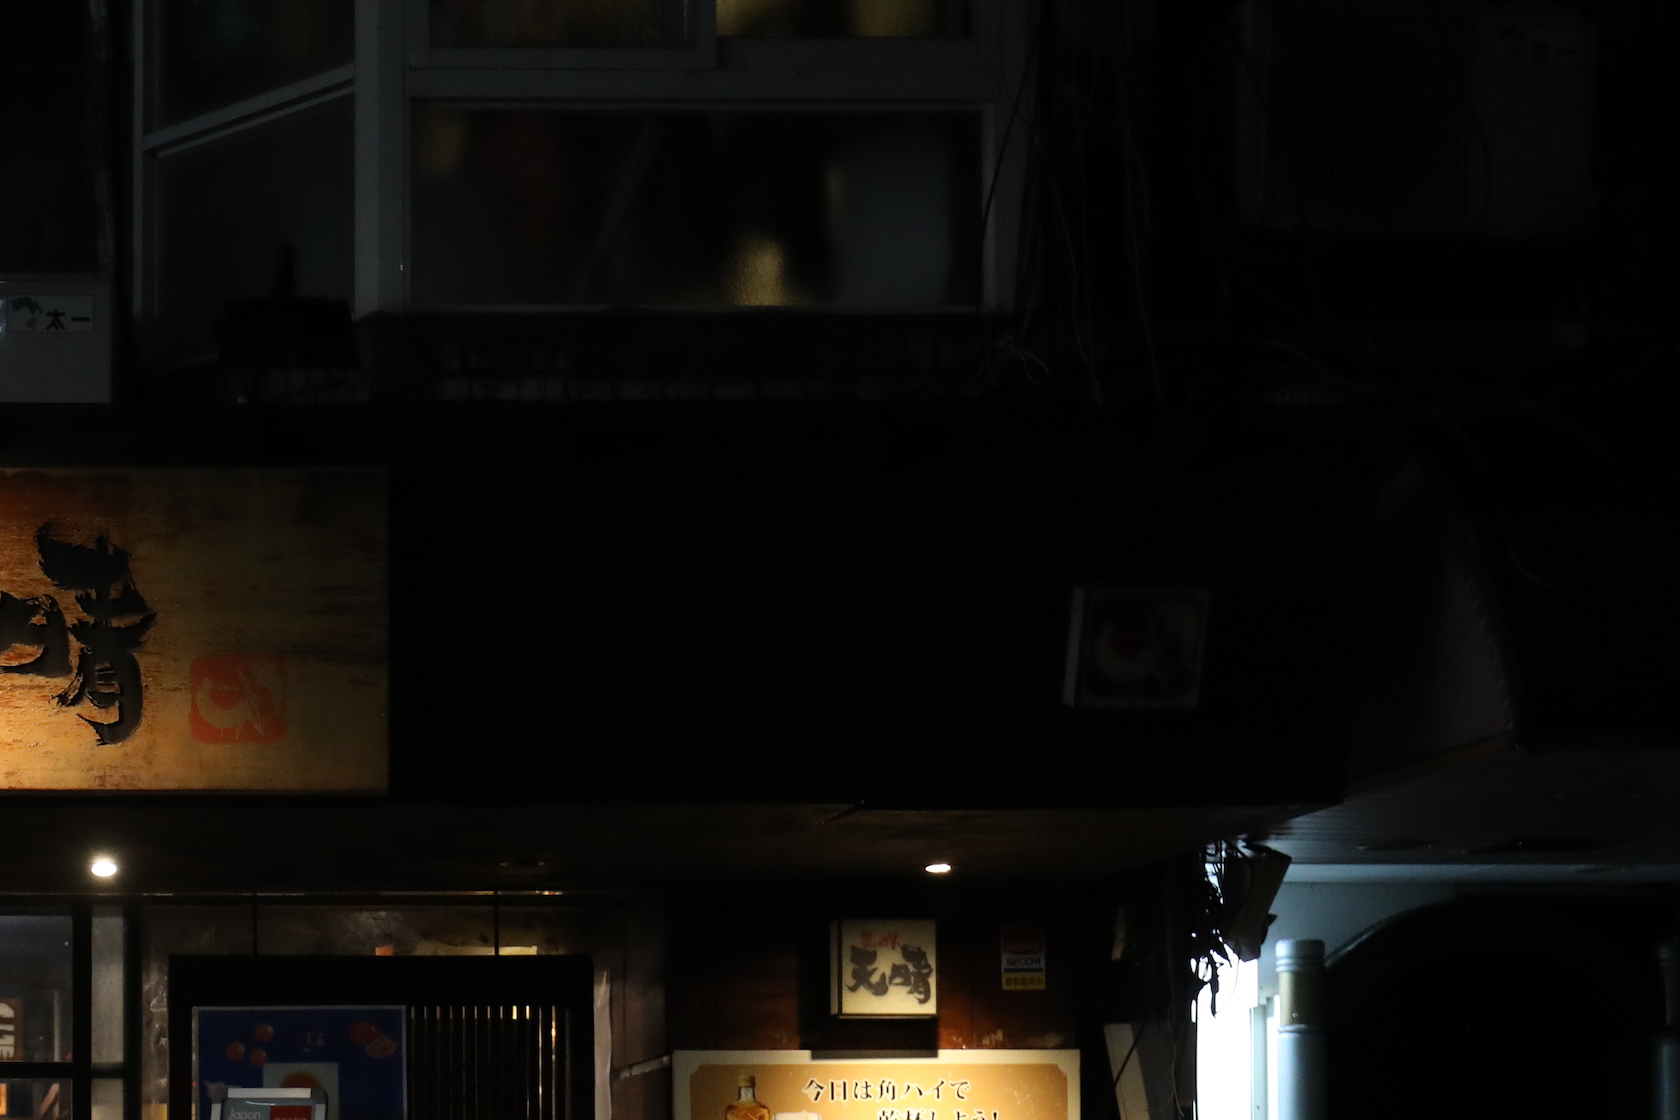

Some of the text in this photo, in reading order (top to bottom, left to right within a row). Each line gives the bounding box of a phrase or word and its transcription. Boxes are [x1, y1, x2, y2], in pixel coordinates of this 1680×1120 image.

[803, 1077, 971, 1102] 今日は角ハイで
